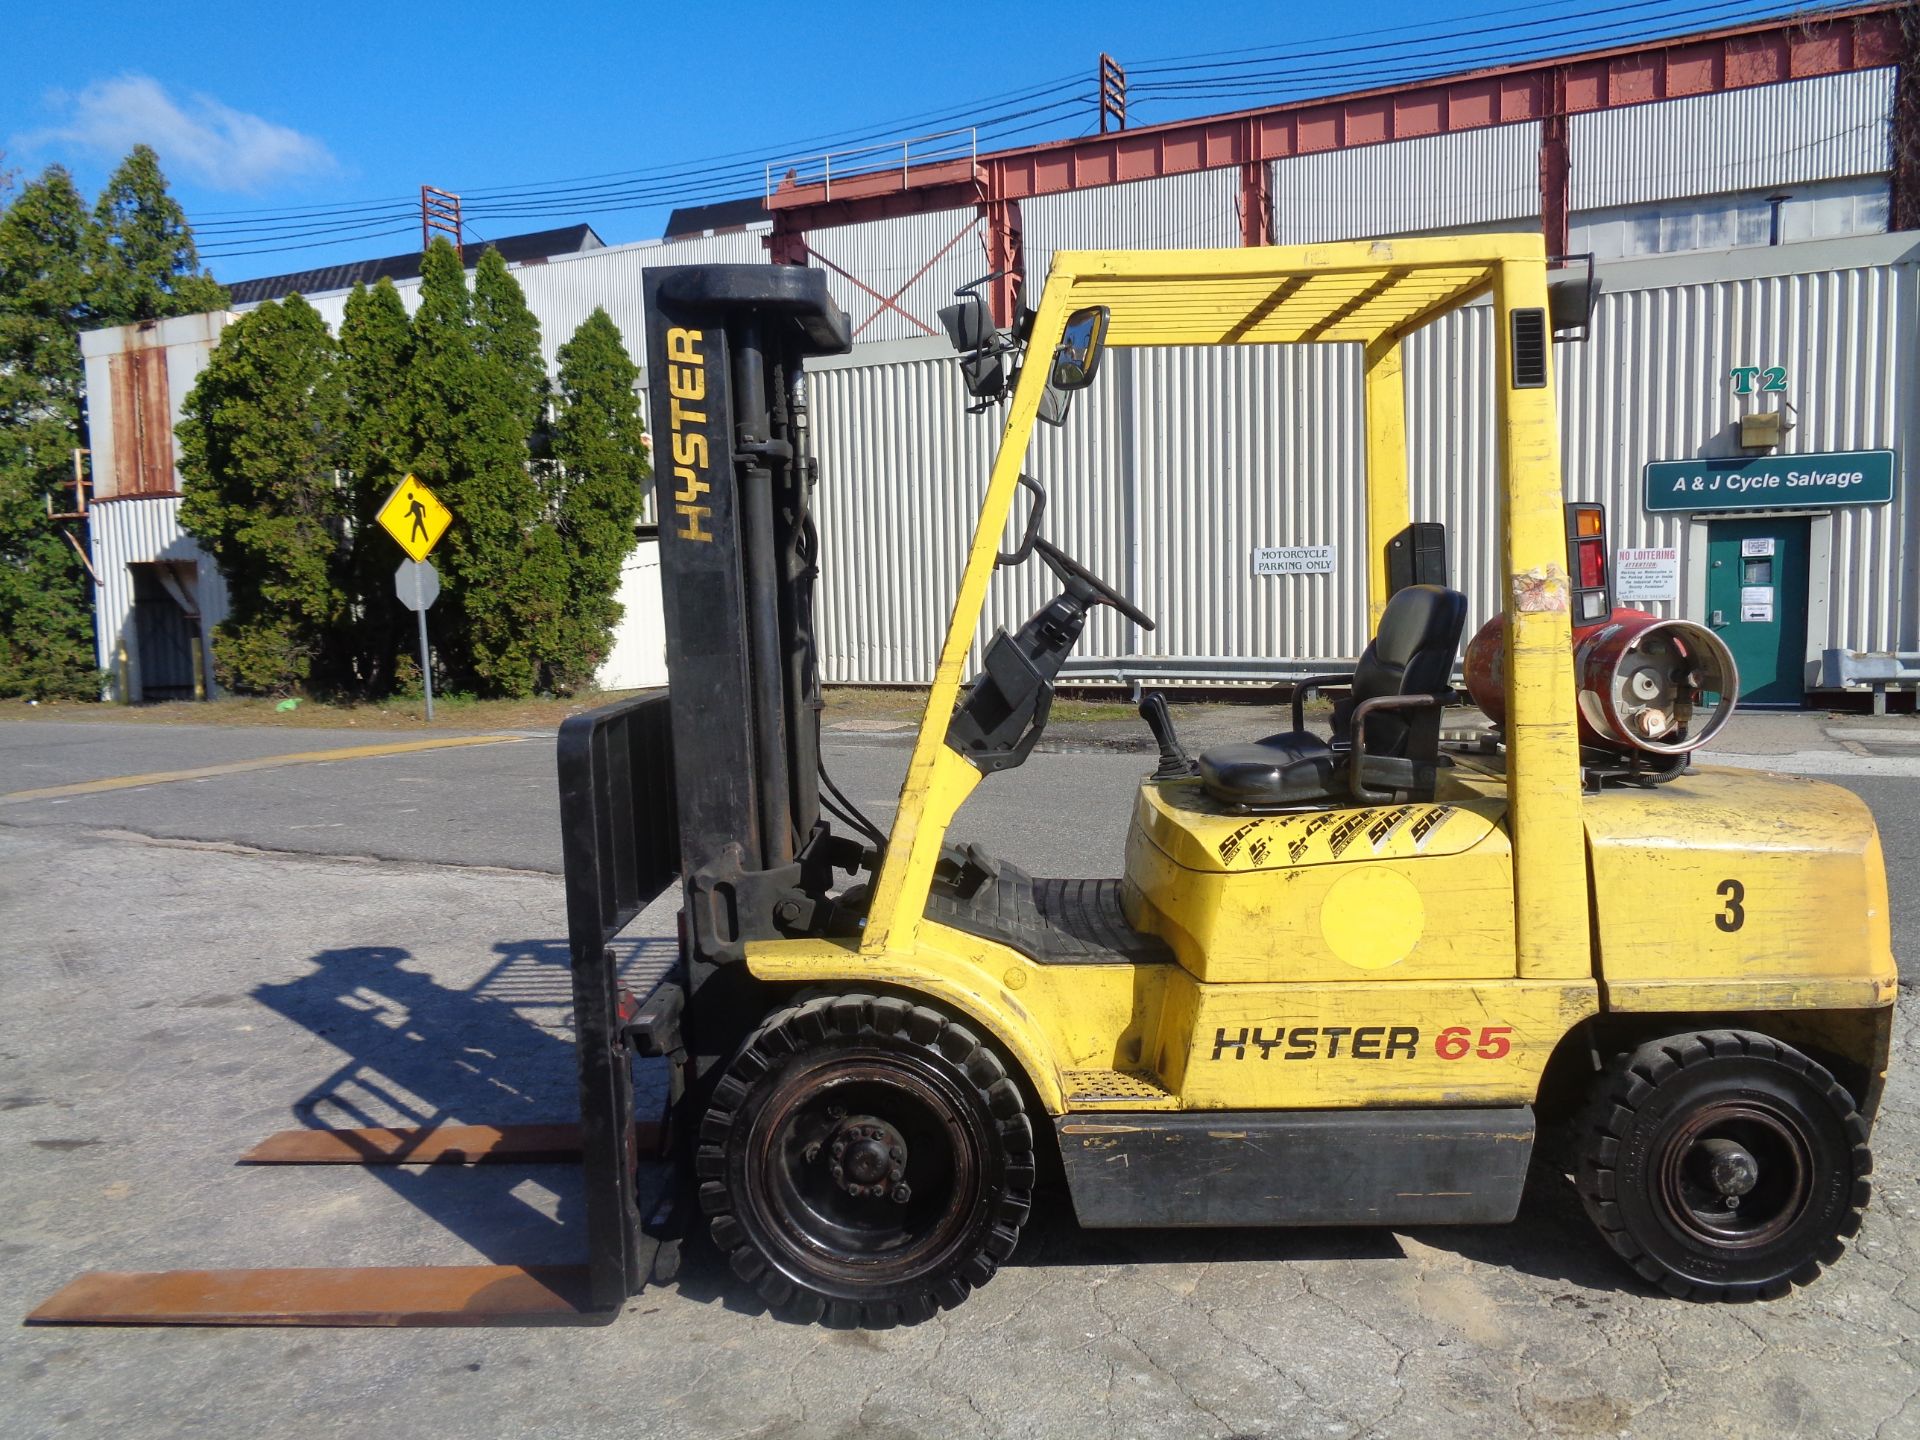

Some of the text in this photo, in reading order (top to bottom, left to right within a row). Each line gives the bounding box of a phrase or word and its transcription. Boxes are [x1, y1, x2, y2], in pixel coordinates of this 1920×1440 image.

[667, 327, 713, 542] HYSTER
[1673, 471, 1863, 492] A & J Cycle Salvage
[1261, 550, 1328, 559] MOTORCYCLE
[1620, 550, 1675, 560] NO LOITERING
[1258, 560, 1332, 571] PARKING ONLY
[1715, 879, 1745, 933] 3
[1211, 1027, 1511, 1060] HYSTER 65
